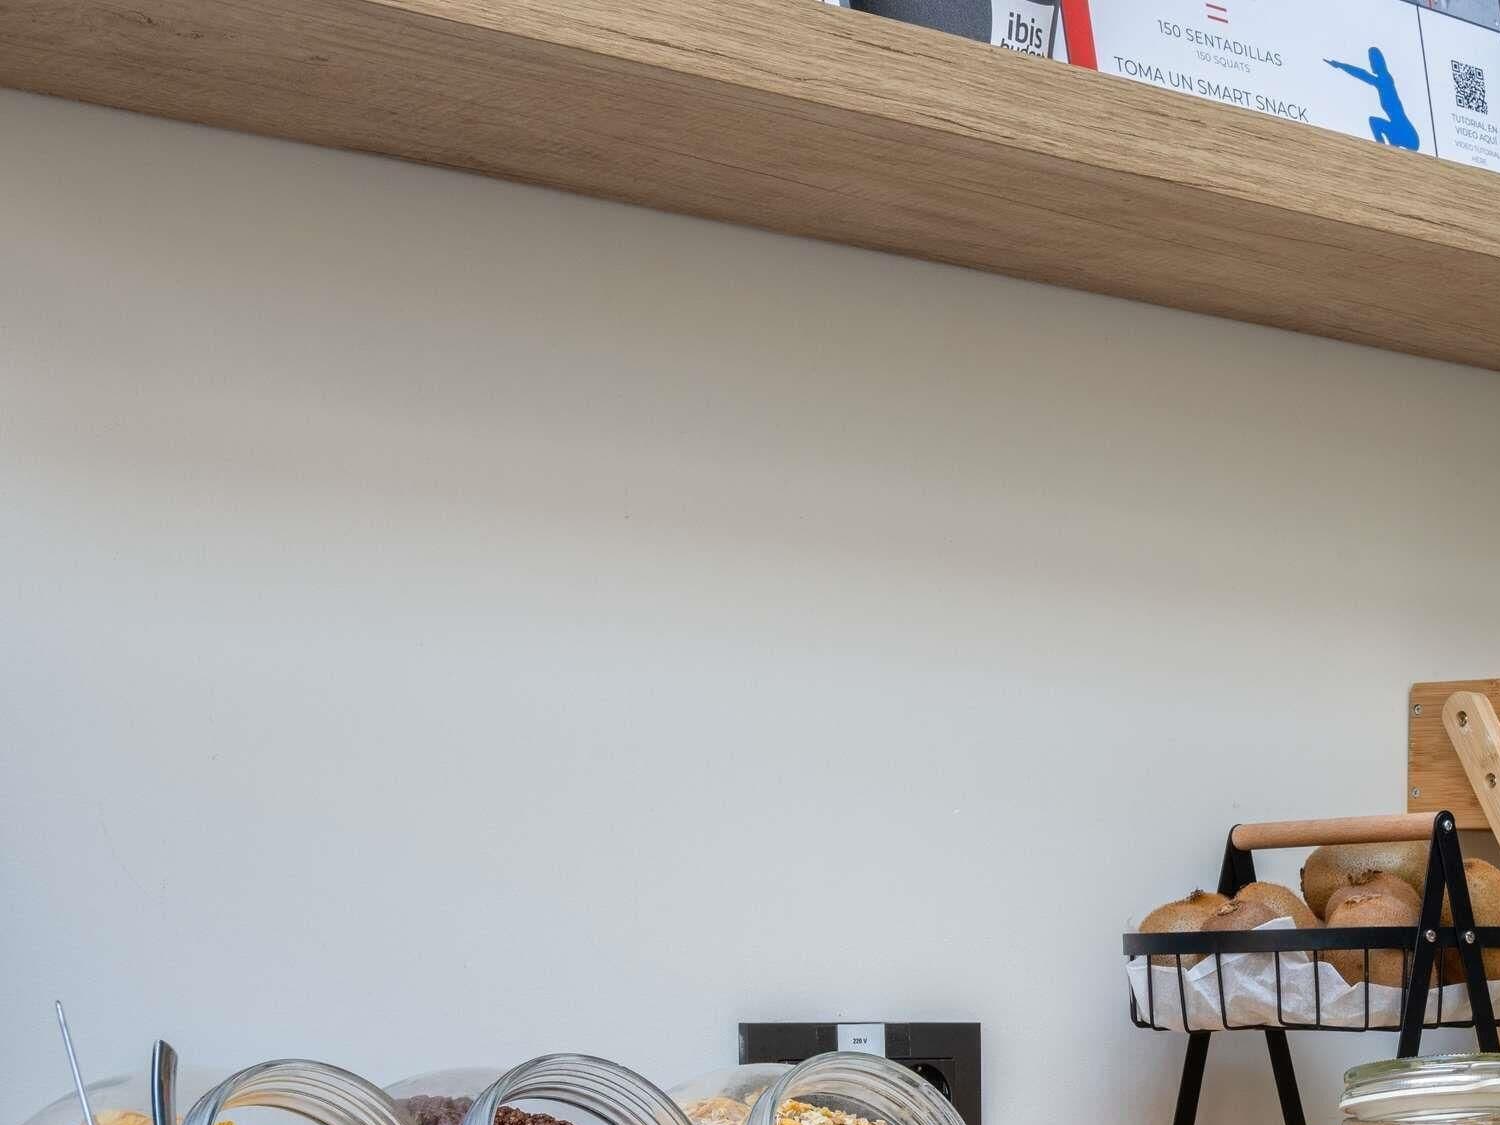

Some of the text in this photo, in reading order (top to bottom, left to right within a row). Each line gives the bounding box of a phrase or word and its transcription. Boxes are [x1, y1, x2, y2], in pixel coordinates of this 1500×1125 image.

[1007, 12, 1043, 49] ibis
[1157, 20, 1283, 66] 150 SENTADILLAS
[1214, 55, 1251, 73] SQUATS
[1113, 56, 1309, 122] TOMA UN SMART SNACK
[1451, 113, 1487, 132] TUTORIAL
